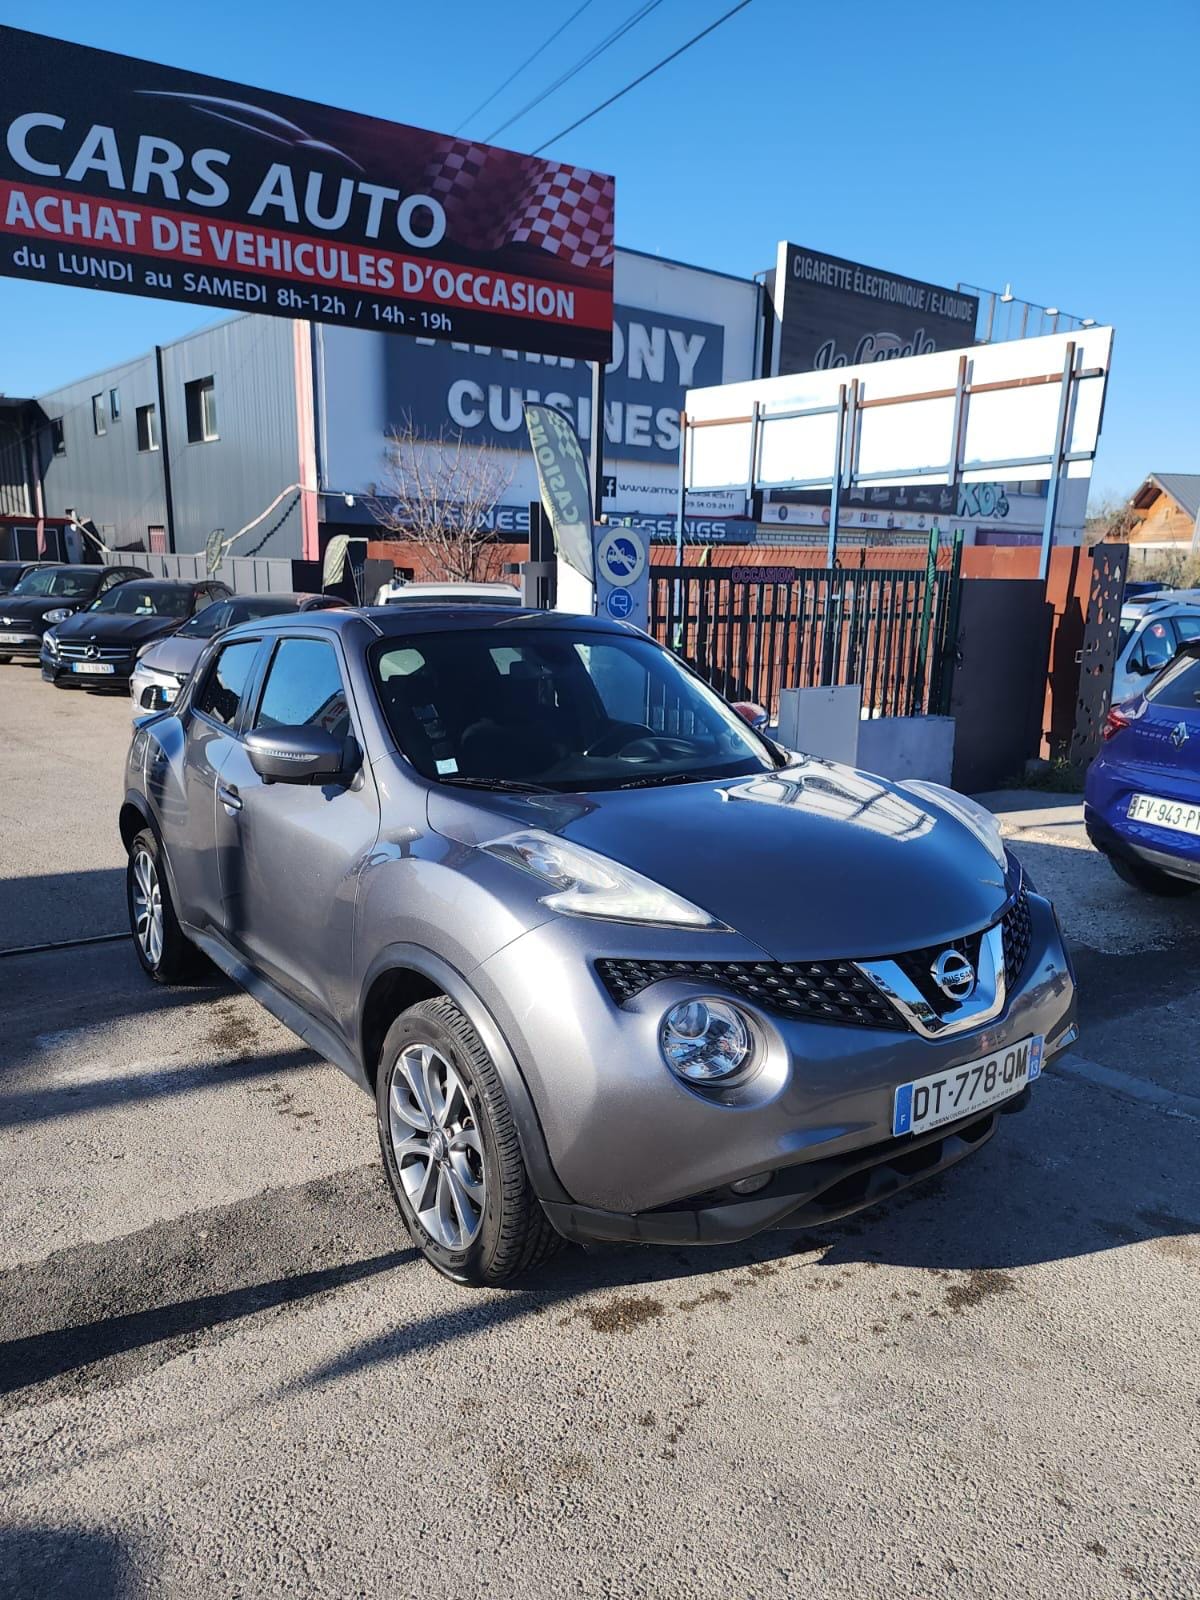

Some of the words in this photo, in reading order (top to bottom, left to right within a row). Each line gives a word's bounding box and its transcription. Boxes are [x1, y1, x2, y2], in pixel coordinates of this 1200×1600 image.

[6, 111, 232, 208] CARS
[248, 163, 447, 249] AUTO
[5, 190, 141, 247] ACHAT
[151, 216, 203, 257] DE
[208, 226, 395, 291] VEHICULES
[402, 264, 575, 321] D'OCCASION
[13, 245, 46, 272] du
[58, 251, 134, 284] LUNDI
[145, 270, 174, 290] au
[183, 272, 268, 304] SAMEDI
[277, 287, 346, 317] 8h-12h
[793, 254, 852, 291] CIGARETTE
[853, 266, 925, 311] ÉLECTRONIQUE
[931, 292, 974, 322] E-LIQUIDE
[447, 379, 681, 451] CUSINES
[732, 566, 796, 583] OCCASION
[913, 1044, 1029, 1122] DT-778-QM
